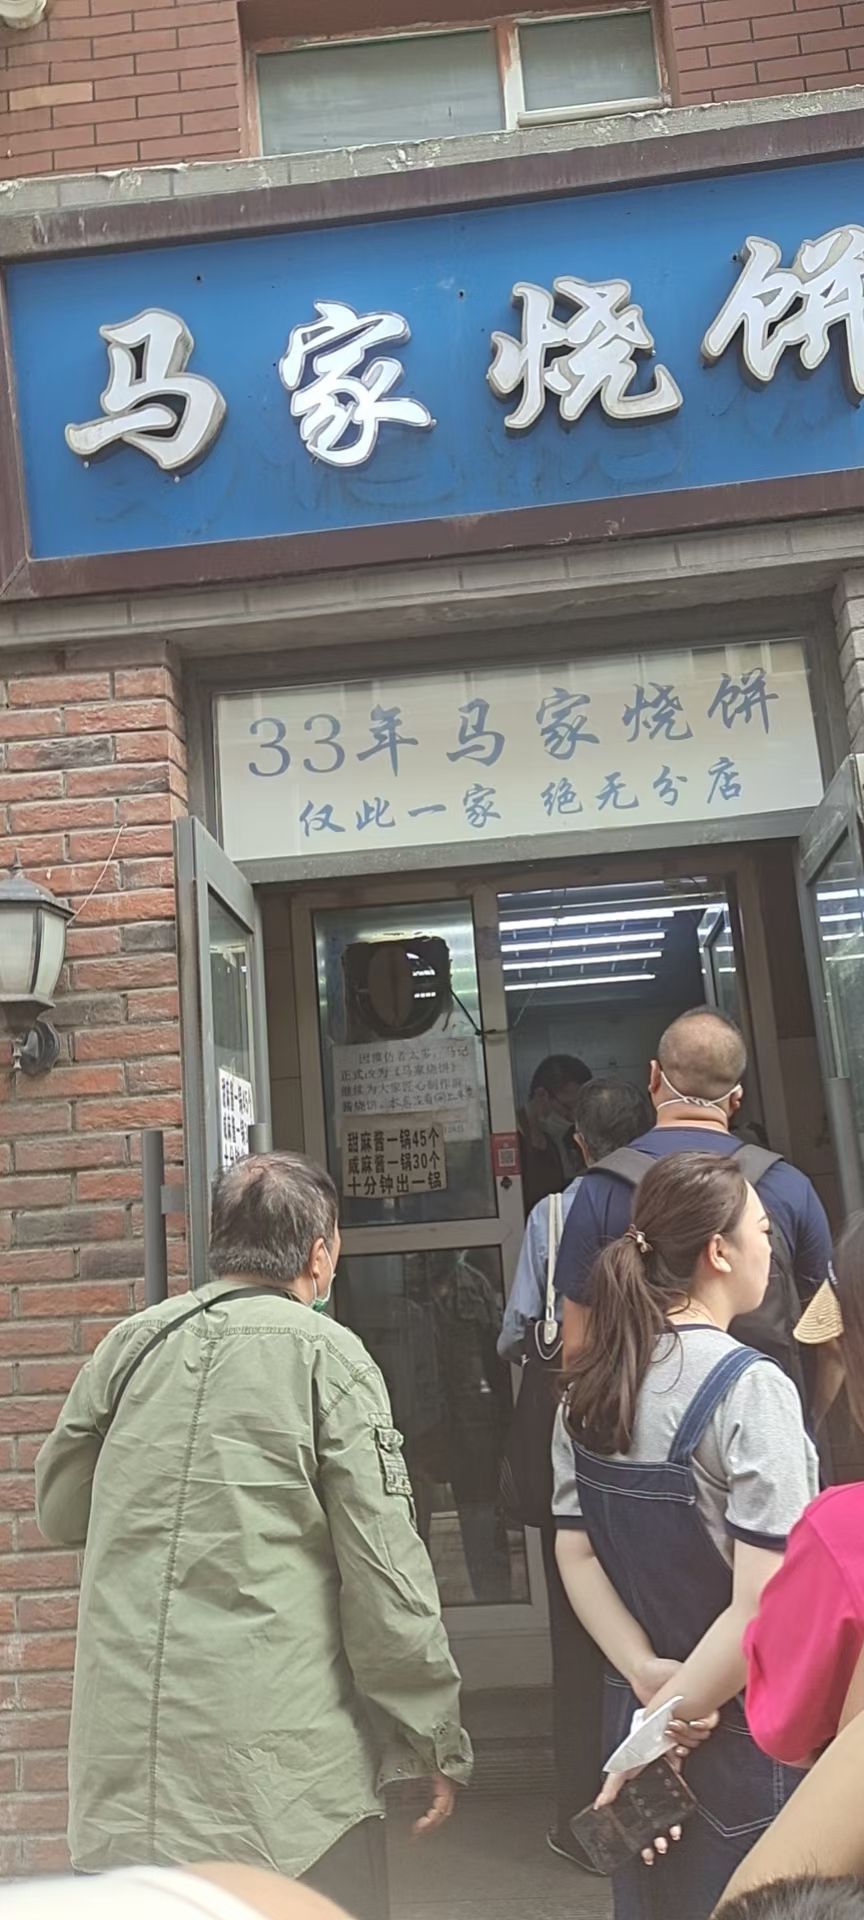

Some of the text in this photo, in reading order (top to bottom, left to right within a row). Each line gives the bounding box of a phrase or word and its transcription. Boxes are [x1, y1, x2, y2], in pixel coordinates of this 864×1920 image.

[64, 224, 864, 471] 马家烧饼
[300, 756, 743, 838] 仅此一家 绝无分店
[347, 1127, 439, 1153] 甜麻酱一锅45个
[347, 1171, 442, 1195] 十分钟出一锅
